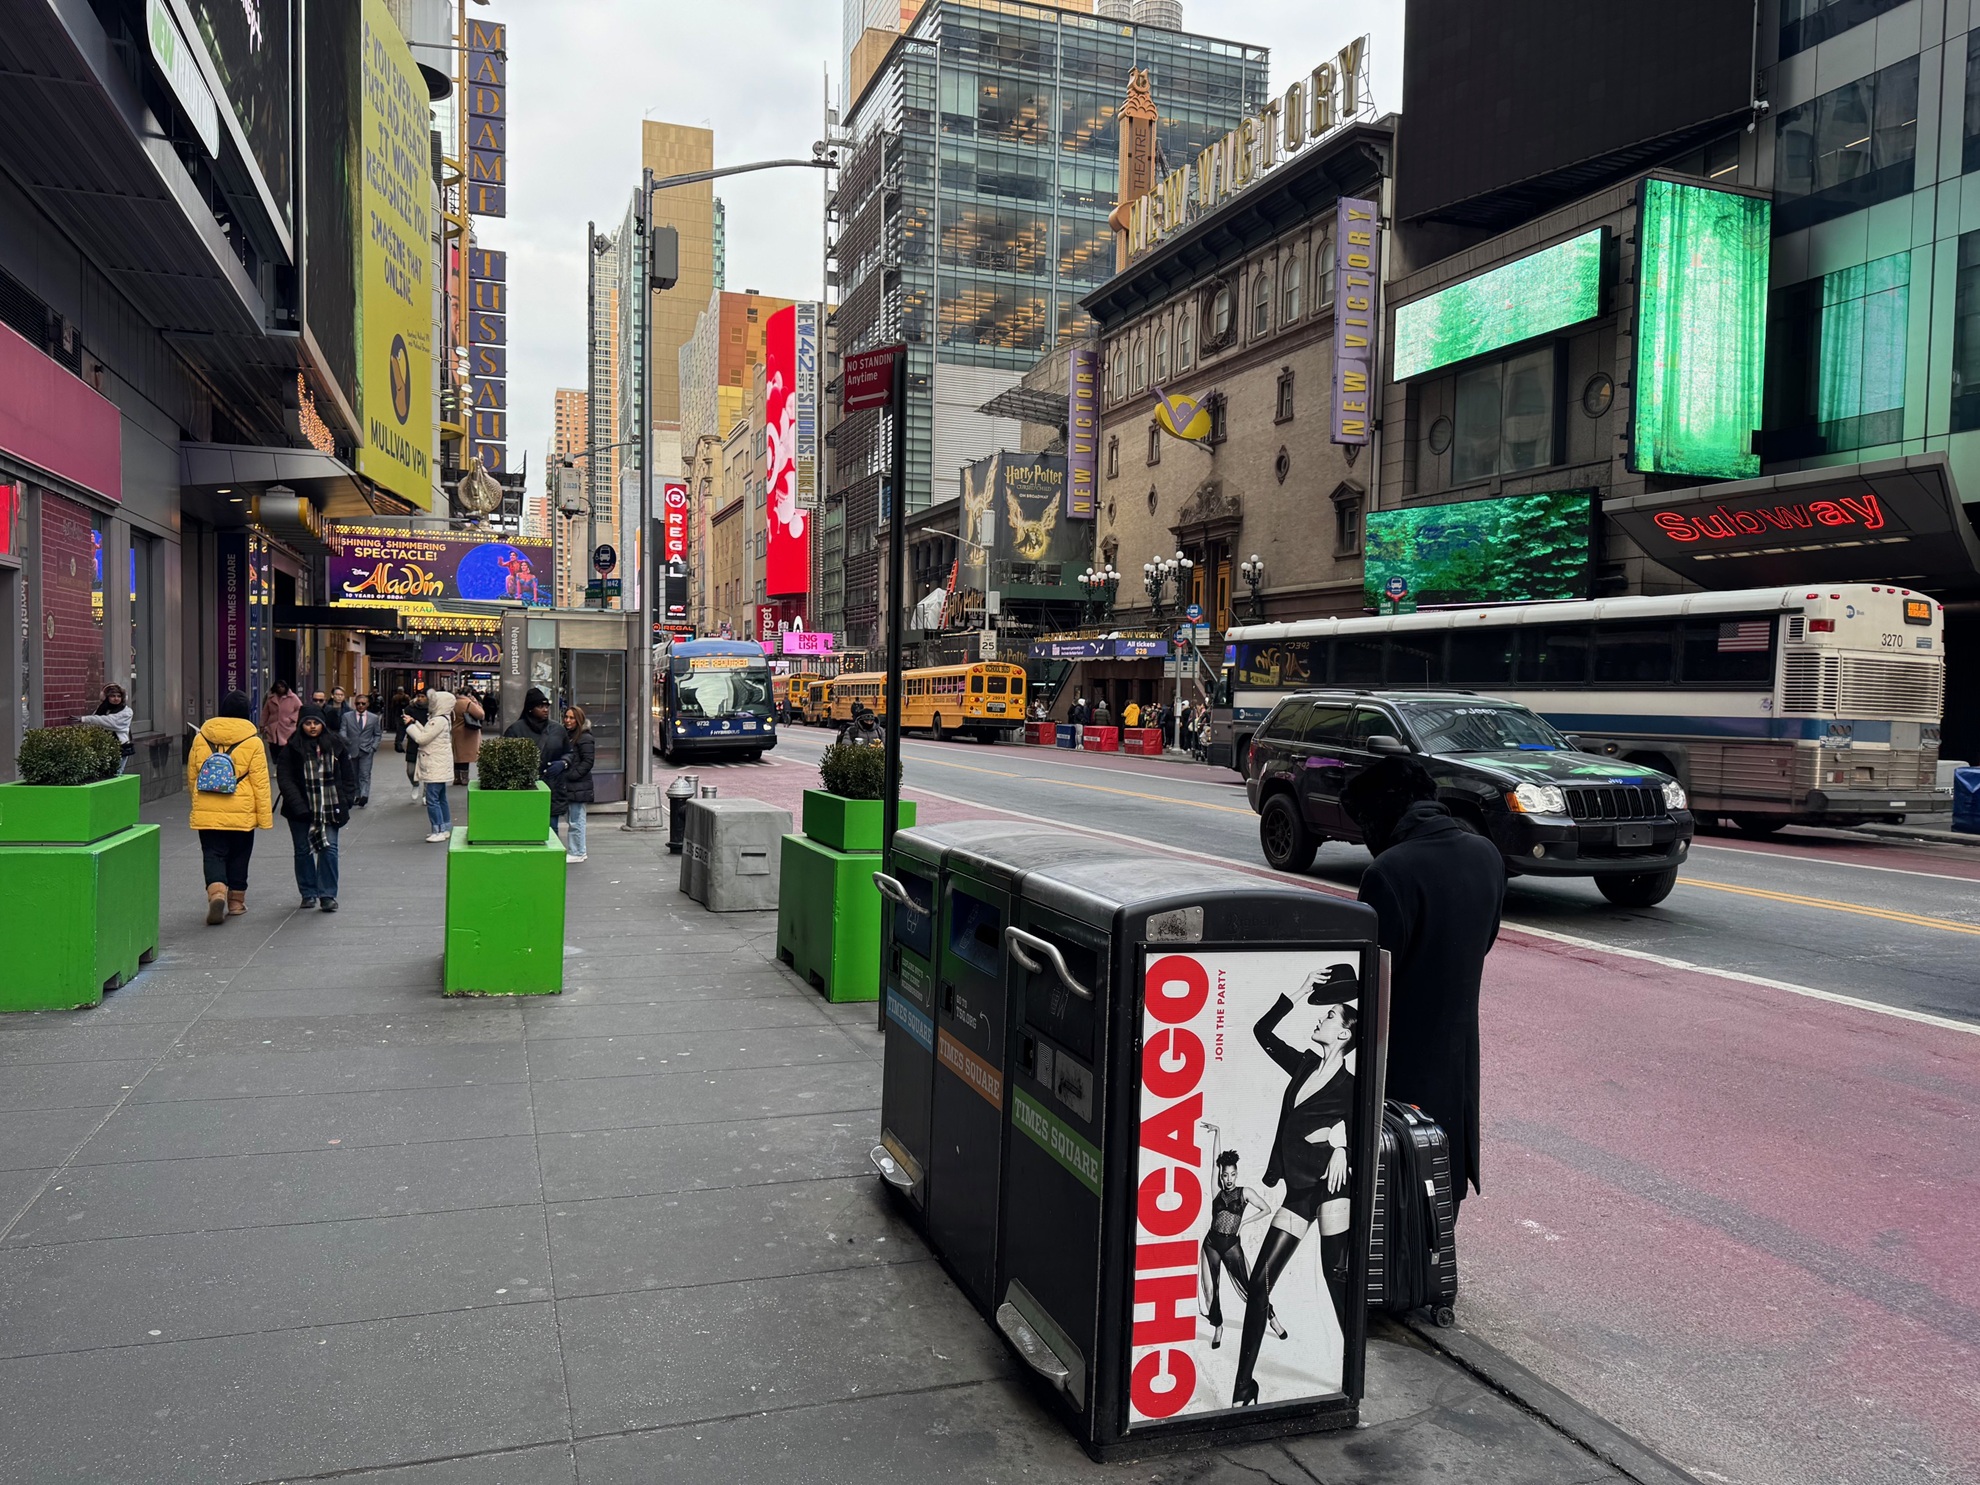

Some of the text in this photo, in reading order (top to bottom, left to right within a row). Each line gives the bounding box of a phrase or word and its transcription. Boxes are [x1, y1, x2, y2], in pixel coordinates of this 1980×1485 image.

[363, 60, 385, 117] THIS
[387, 94, 400, 137] AD
[372, 32, 390, 86] YOU
[392, 62, 412, 119] EVER
[474, 23, 503, 214] MADAME
[378, 121, 419, 198] IT WON'T
[1128, 36, 1366, 257] NEW VICTORY
[1133, 126, 1147, 192] THEATRE
[366, 146, 412, 227] RECOGNIZE
[370, 209, 423, 285] IMAGINE THAT
[798, 303, 815, 337] NEW
[1341, 208, 1371, 436] NEW VICTORY
[798, 337, 815, 372] 42
[847, 360, 858, 372] NO
[847, 371, 878, 386] Anytime
[370, 416, 427, 479] MULLVAD VPN
[798, 393, 815, 454] STUDIOS
[1073, 357, 1094, 514] NEW VICTORY
[1004, 464, 1063, 486] Harry Potter
[1653, 494, 1886, 543] Subway
[341, 537, 447, 551] SHINING, SHIMMERING
[354, 547, 437, 561] SPECTACLE!
[669, 513, 684, 577] REGAL
[227, 553, 236, 594] SQUARE
[343, 562, 444, 596] Aladdin
[227, 594, 237, 623] TIMES
[228, 623, 237, 660] BETTER
[511, 626, 520, 675] Newsstand
[690, 658, 748, 668] FARE REQUIRED
[799, 642, 818, 650] LISH
[981, 642, 995, 650] 25
[1136, 640, 1156, 648] tickets
[1881, 633, 1903, 648] 3270
[887, 994, 932, 1046] TIMES SQUARE
[1215, 969, 1227, 1061] JOIN THE PARTY
[938, 1037, 1000, 1100] TIMES SQUARE
[1014, 1096, 1099, 1183] TIMES SQUARE
[1130, 954, 1210, 1419] CHICAGO
